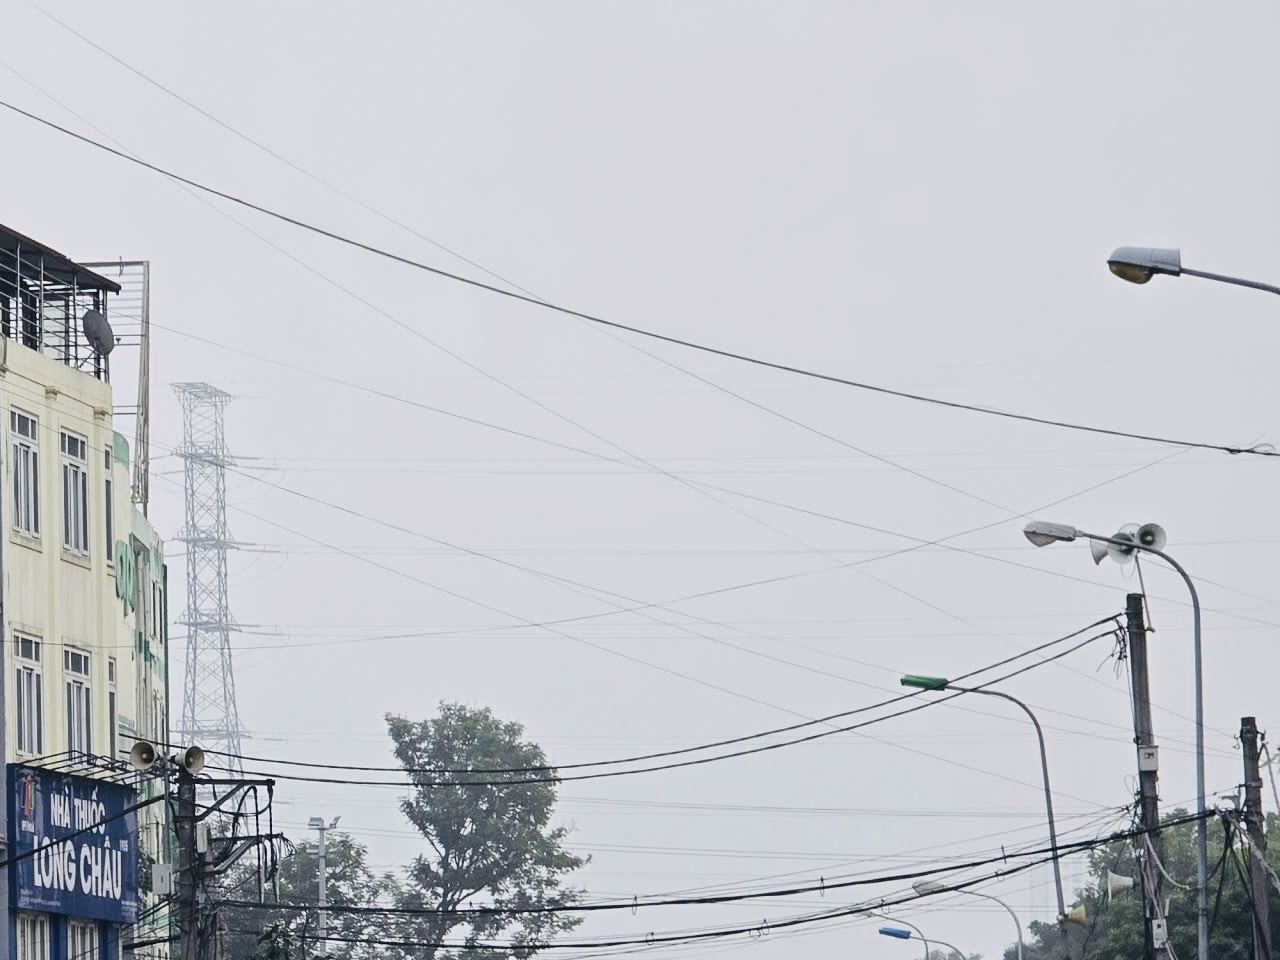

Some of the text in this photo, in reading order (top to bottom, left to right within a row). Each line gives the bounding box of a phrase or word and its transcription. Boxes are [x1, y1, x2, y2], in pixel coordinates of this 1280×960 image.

[50, 785, 106, 835] NHÀ THUỐC
[33, 835, 122, 900] LONG CHÂU
